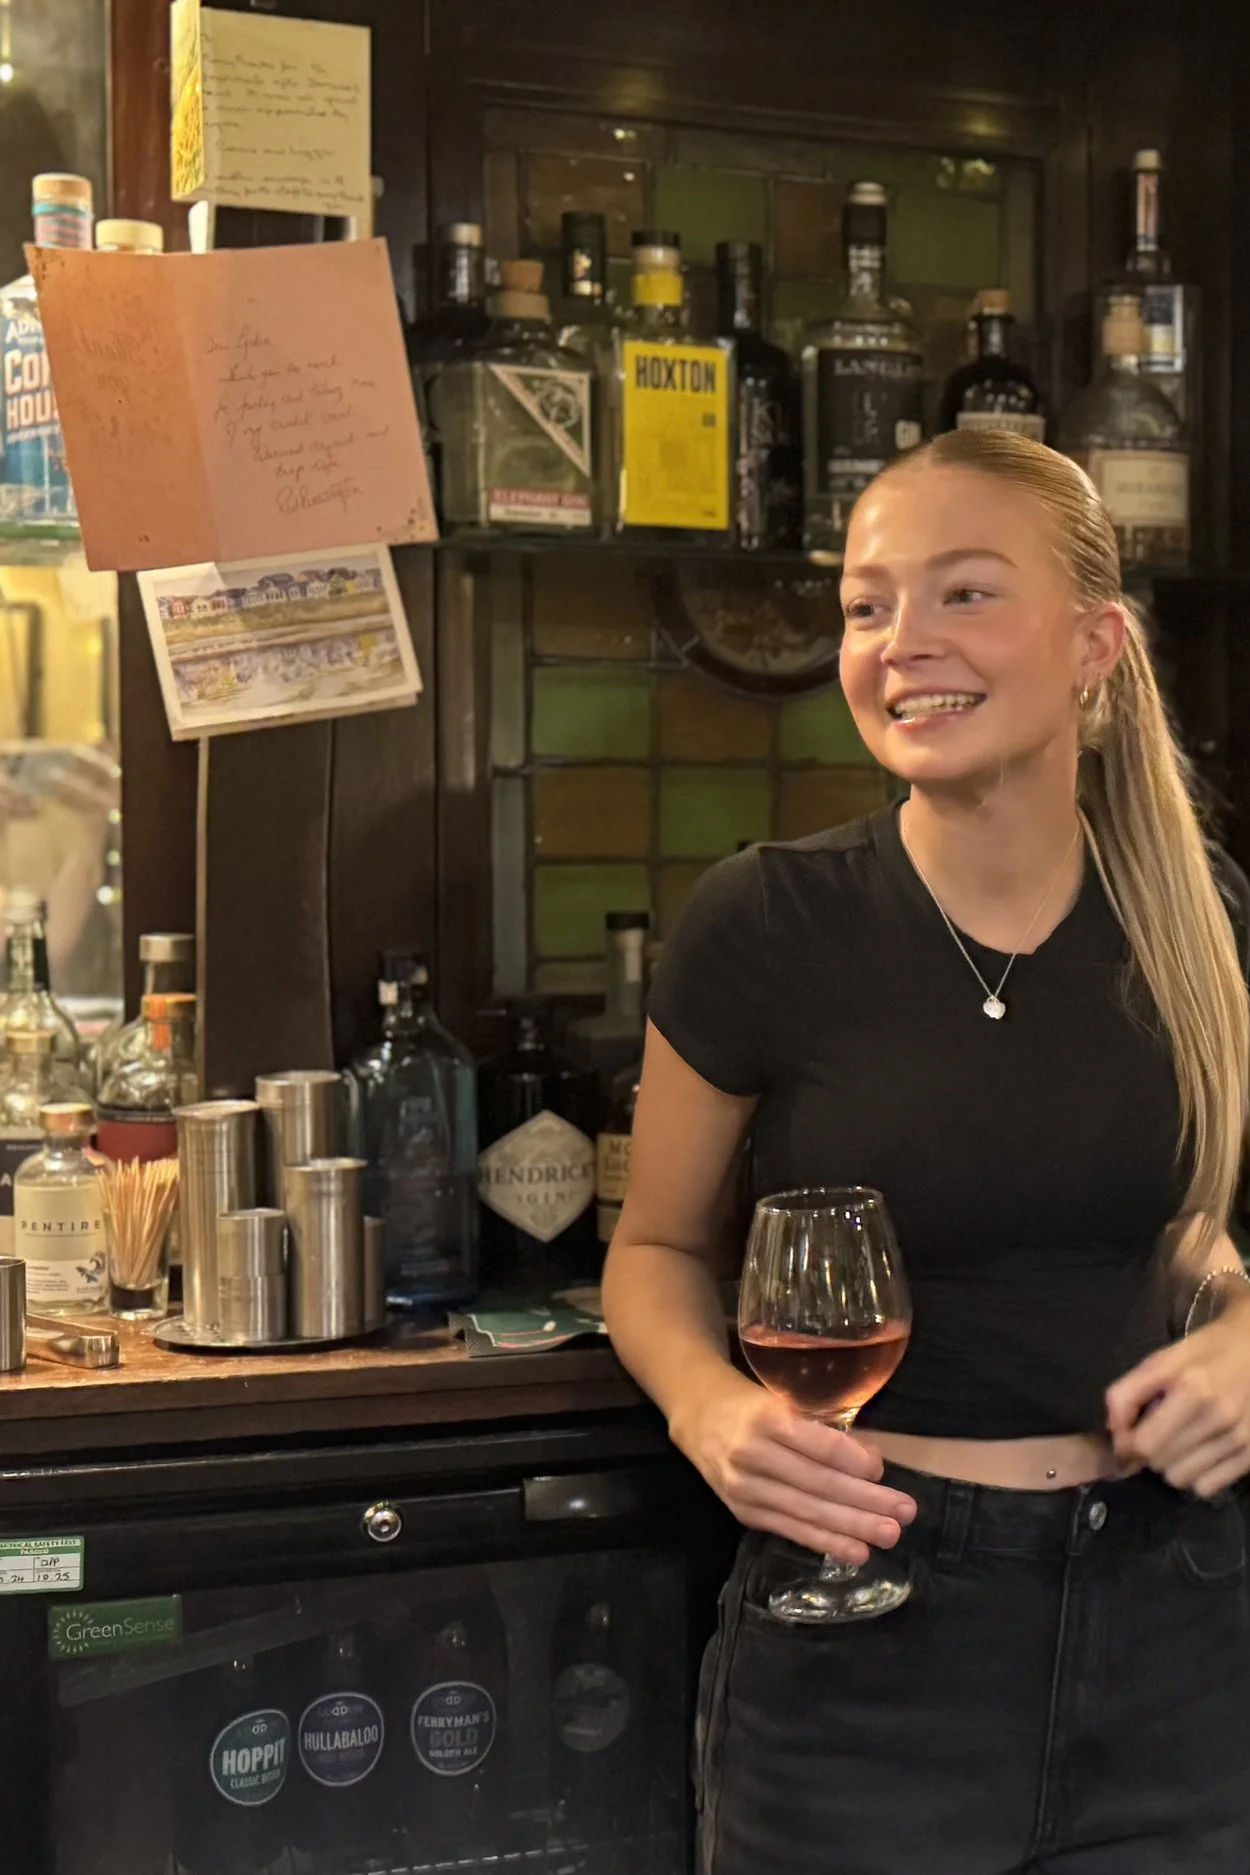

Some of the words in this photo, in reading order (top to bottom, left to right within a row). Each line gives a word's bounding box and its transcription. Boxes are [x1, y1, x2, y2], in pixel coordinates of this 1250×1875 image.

[635, 354, 718, 395] HOXTON
[20, 1219, 101, 1233] PENTIRE
[66, 1617, 176, 1641] GreenSense
[303, 1724, 379, 1752] HULLABALOO
[429, 1728, 479, 1748] GOLD
[221, 1737, 287, 1777] HOPPIT
